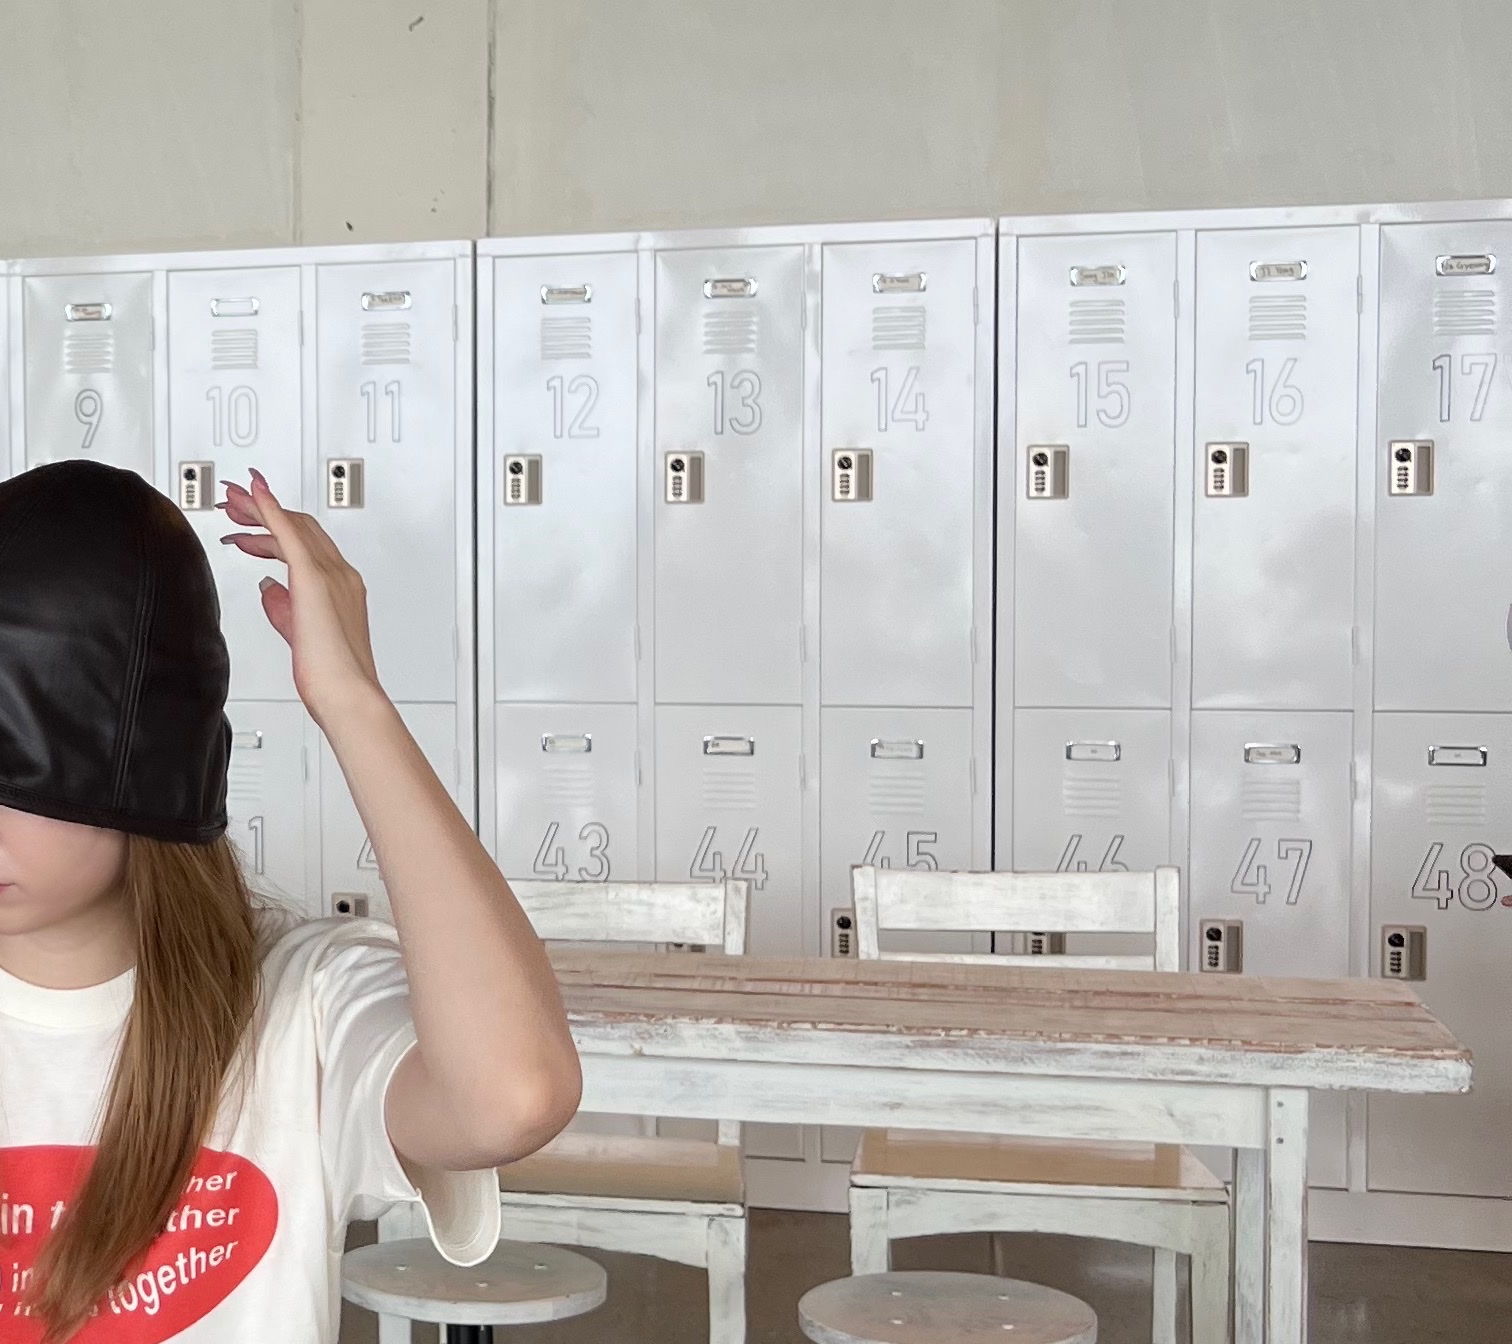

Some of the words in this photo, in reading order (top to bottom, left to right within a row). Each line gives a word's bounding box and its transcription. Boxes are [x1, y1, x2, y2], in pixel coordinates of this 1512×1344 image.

[73, 388, 104, 449] 9
[205, 384, 261, 448] 10
[360, 380, 404, 443] 11
[545, 374, 601, 439] 12
[706, 369, 763, 436] 13
[870, 366, 930, 433] 14
[1069, 360, 1132, 429] 15
[1245, 357, 1305, 426] 16
[1432, 353, 1498, 423] 17
[533, 822, 611, 883] 43
[690, 826, 768, 890] 44
[1230, 837, 1312, 905] 47
[1412, 842, 1498, 911] 48
[1, 1192, 34, 1235] in
[107, 1240, 239, 1316] together
